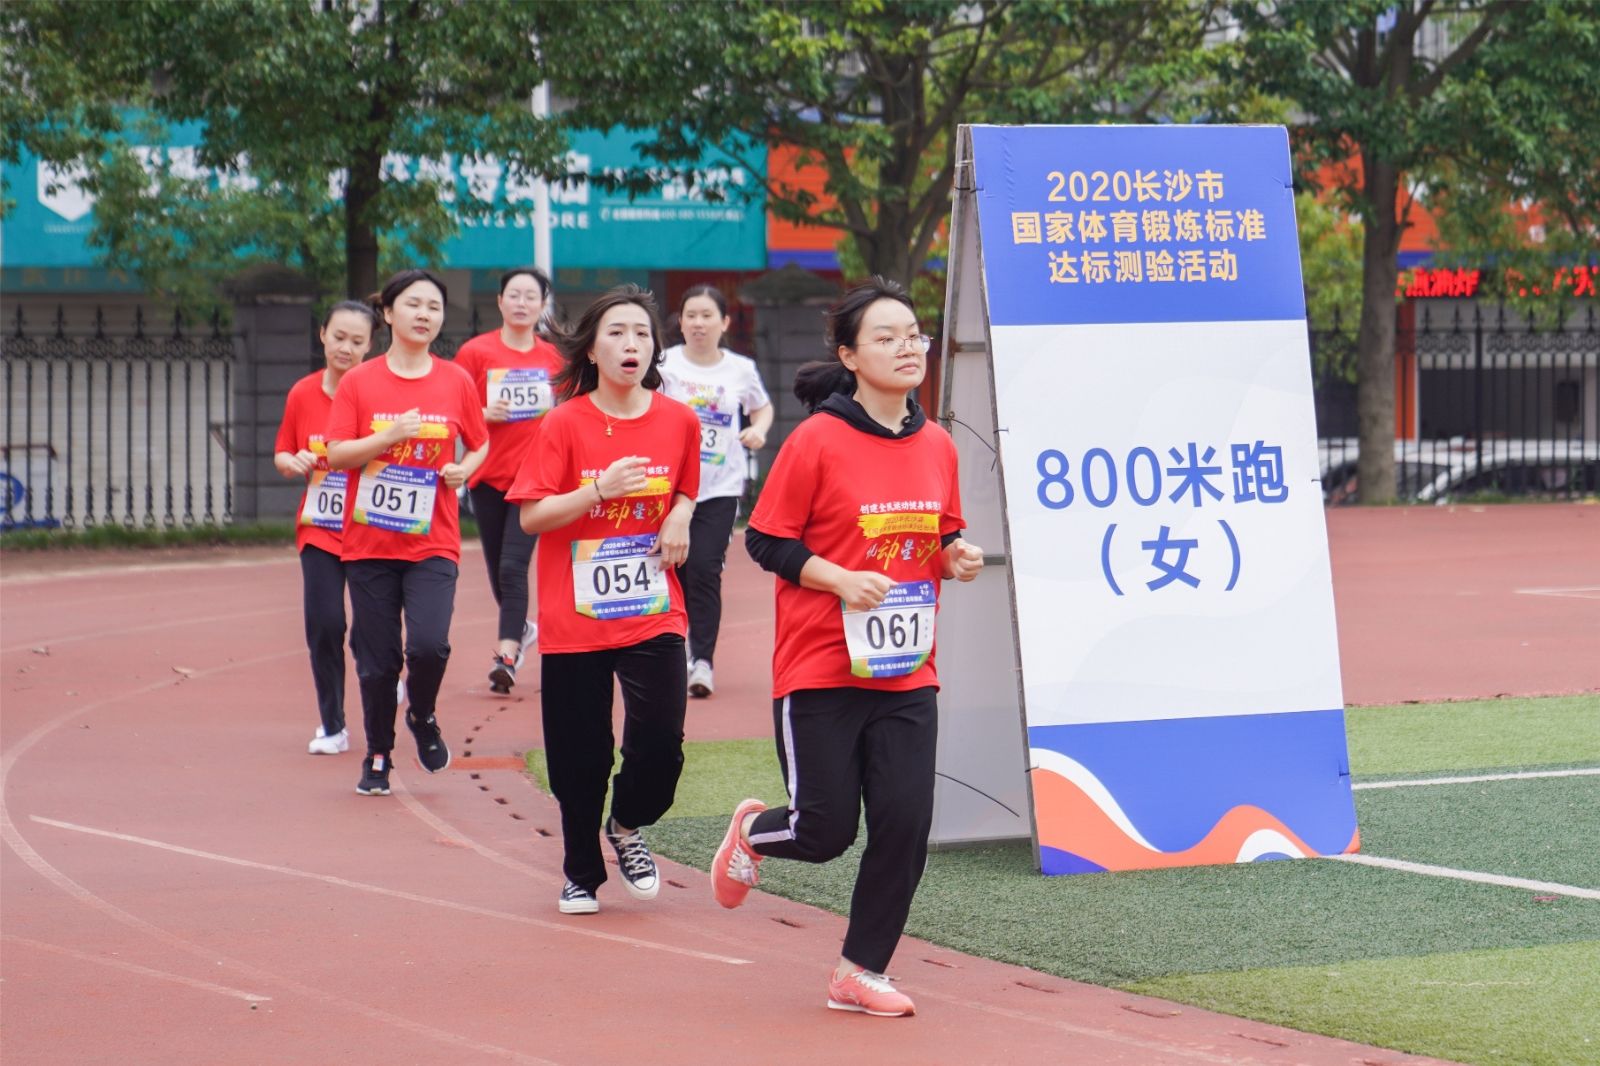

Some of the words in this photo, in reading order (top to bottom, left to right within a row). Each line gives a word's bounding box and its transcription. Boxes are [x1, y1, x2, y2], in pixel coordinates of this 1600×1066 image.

[1046, 169, 1224, 203] 2020长沙市
[1011, 209, 1267, 245] 国家体育锻炼标准
[1048, 248, 1239, 284] 达标测验活动
[500, 386, 538, 407] 055
[1036, 440, 1289, 510] 800米跑
[317, 491, 343, 516] 06
[371, 483, 418, 515] 051
[1100, 519, 1241, 596] （女）
[592, 561, 651, 596] 054
[865, 612, 919, 650] 061
